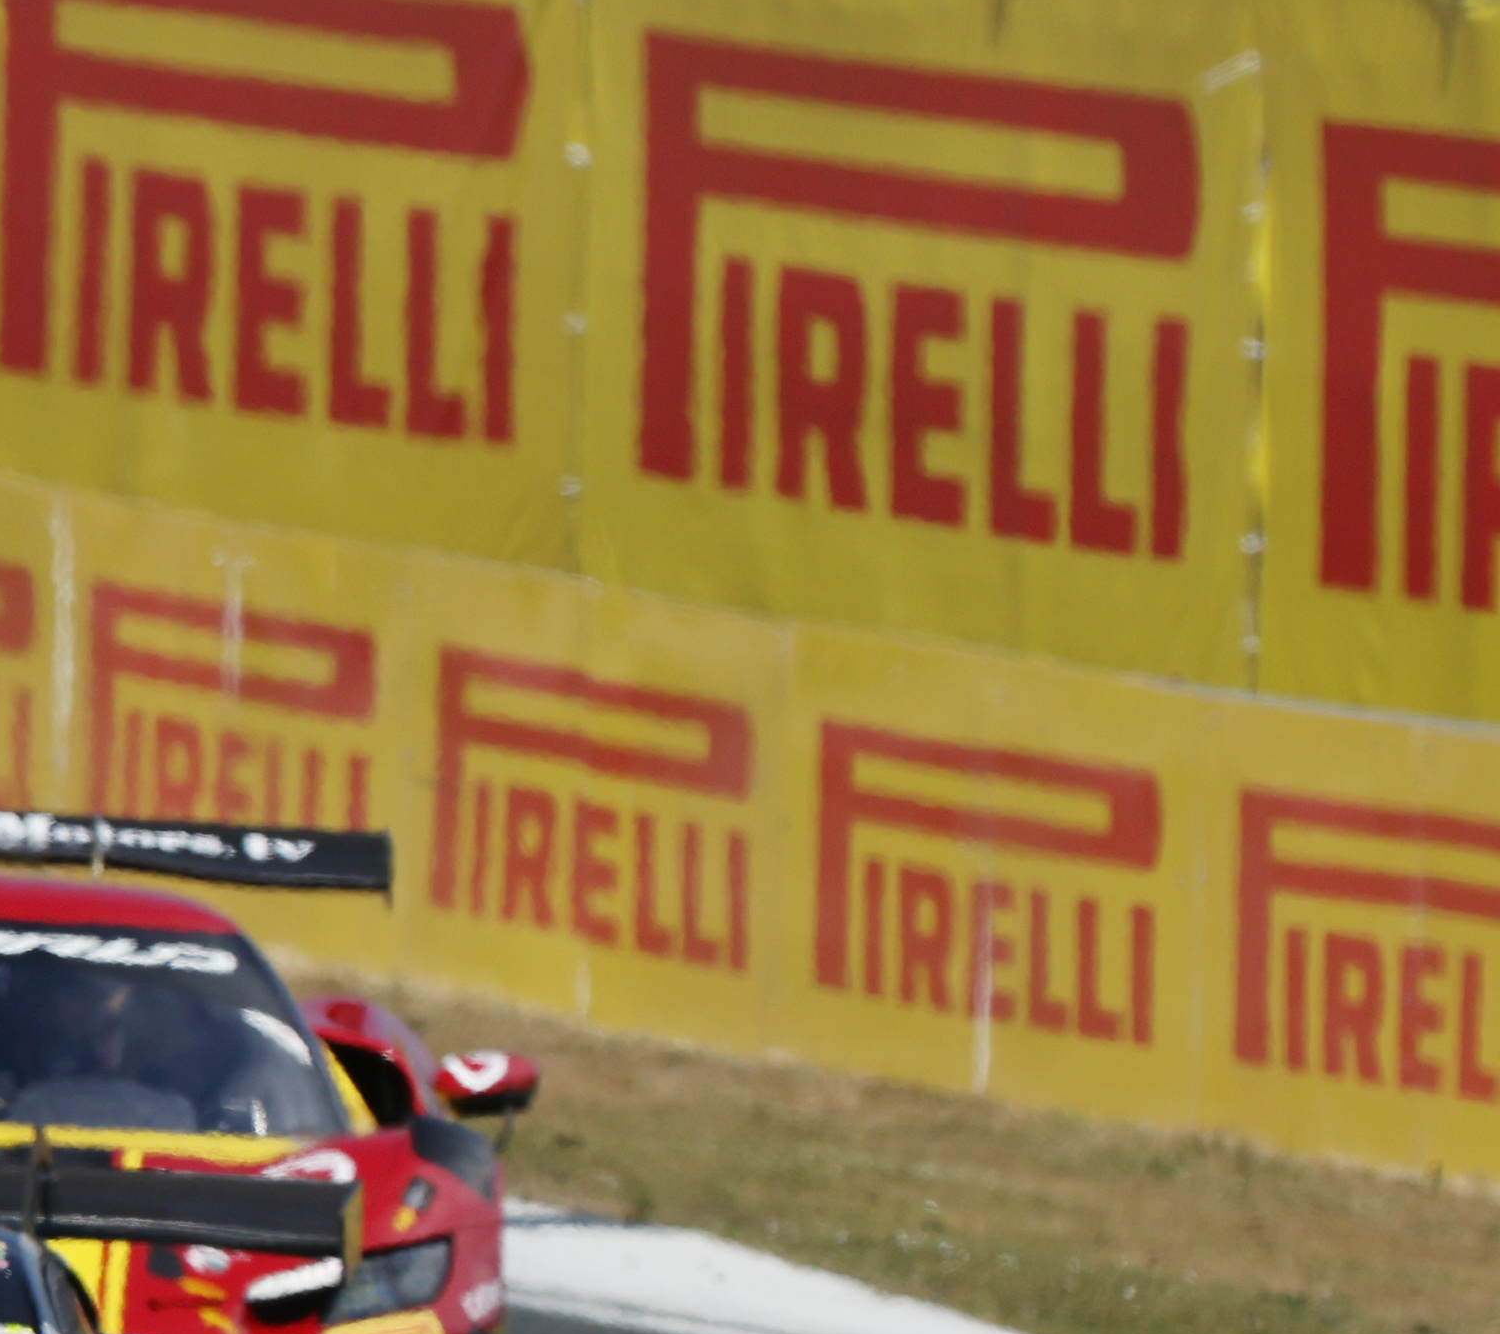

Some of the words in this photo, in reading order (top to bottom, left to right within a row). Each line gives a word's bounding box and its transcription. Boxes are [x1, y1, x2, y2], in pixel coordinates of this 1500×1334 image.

[637, 28, 1201, 562] PIRELLI
[428, 646, 754, 974] PIRELLI
[813, 718, 1163, 1049] PIRELLI
[1233, 787, 1500, 1103] PIREL
